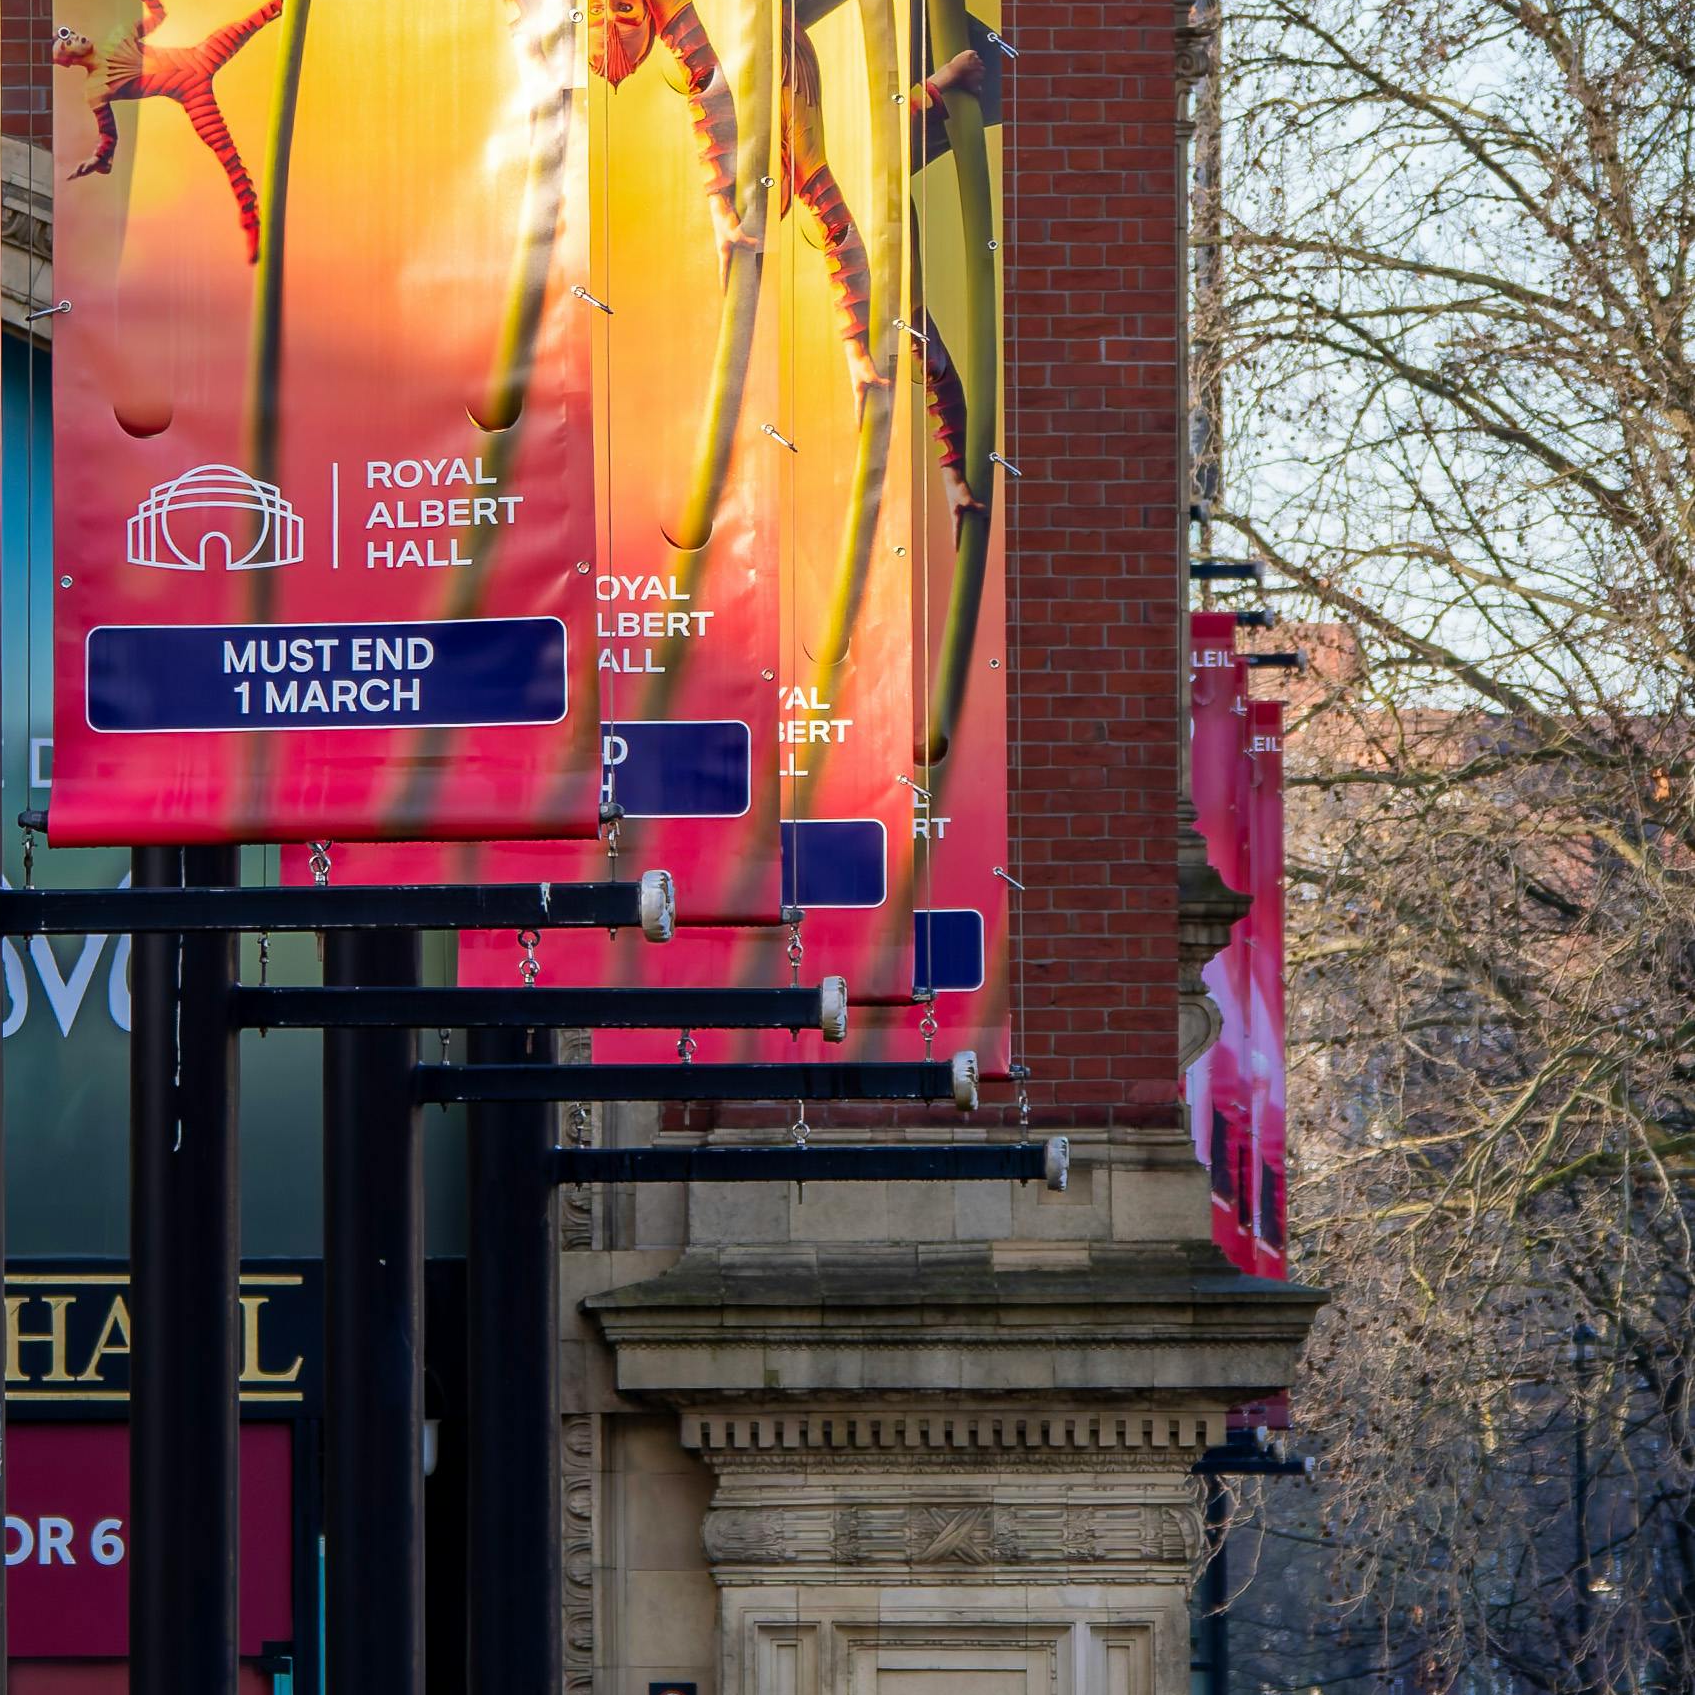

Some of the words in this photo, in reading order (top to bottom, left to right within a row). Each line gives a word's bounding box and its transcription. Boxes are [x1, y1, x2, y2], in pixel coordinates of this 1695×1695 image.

[366, 457, 497, 489] ROYAL
[365, 496, 523, 530] ALBERT
[366, 539, 473, 570] HALL
[596, 575, 690, 601] OYAL
[596, 611, 714, 637] LBERT
[223, 639, 338, 675] MUST
[351, 637, 434, 671] END
[598, 648, 666, 674] ALL
[1192, 650, 1234, 668] LEIL
[234, 683, 250, 714] 1
[265, 678, 421, 714] MARCH
[779, 720, 853, 743] BERT
[4, 1294, 303, 1384] HAL
[5, 1517, 77, 1567] OR
[90, 1517, 125, 1567] 6
